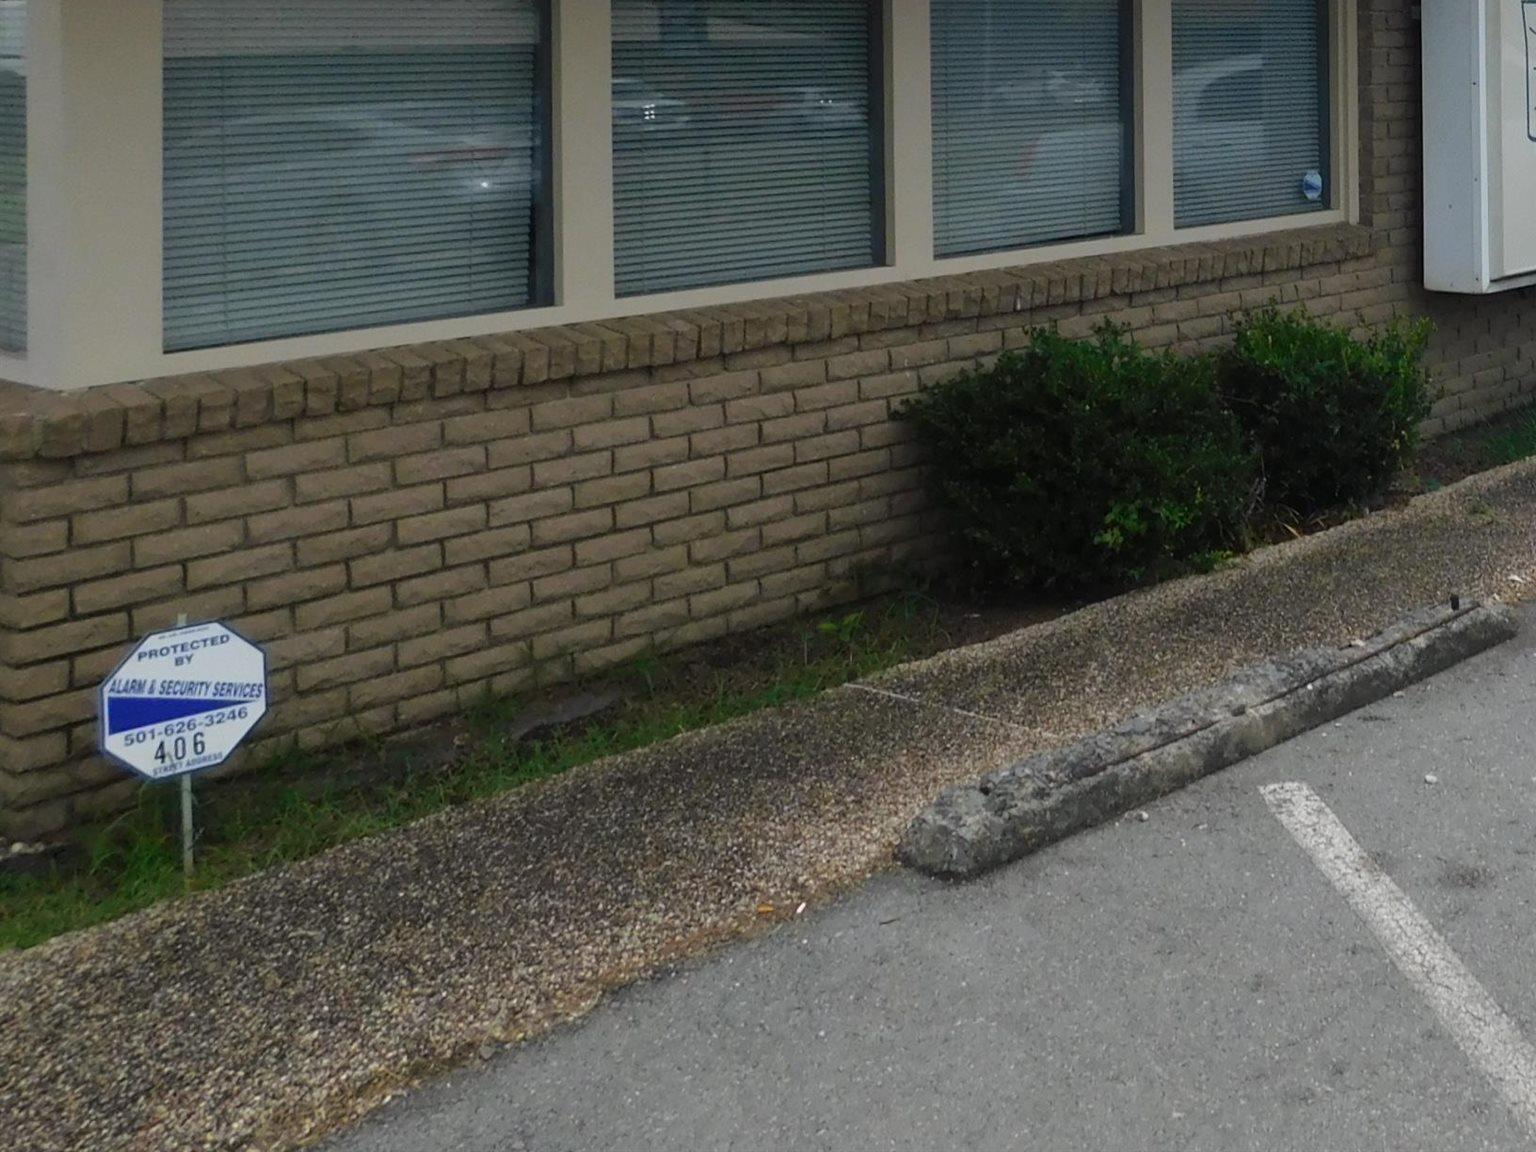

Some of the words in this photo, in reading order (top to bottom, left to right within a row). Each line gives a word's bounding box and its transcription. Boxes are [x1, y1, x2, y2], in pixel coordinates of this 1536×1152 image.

[137, 634, 230, 662] PROTECTED
[174, 654, 194, 667] BY
[109, 679, 147, 695] ALARM
[148, 679, 157, 695] &
[158, 679, 211, 696] SECURITY
[212, 681, 263, 698] SERVICES
[124, 706, 249, 747] 501-626-3246
[154, 731, 206, 764] 406
